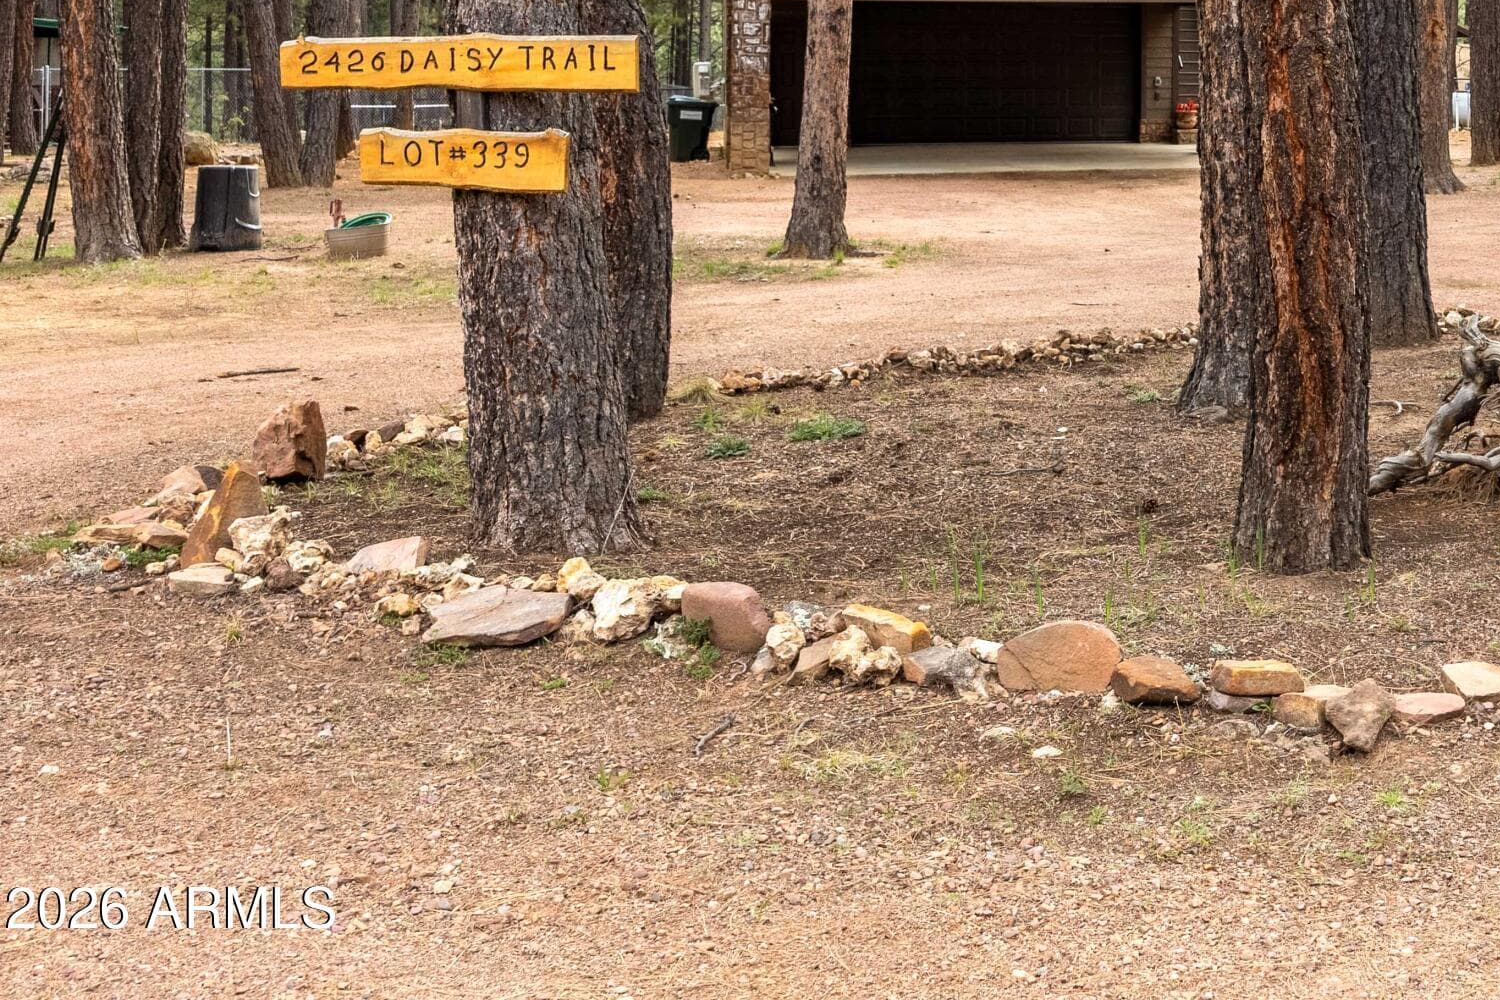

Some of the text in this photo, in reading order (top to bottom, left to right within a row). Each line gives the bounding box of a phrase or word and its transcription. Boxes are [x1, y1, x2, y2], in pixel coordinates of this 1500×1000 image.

[299, 44, 616, 74] 2426 DAISY TRAIL
